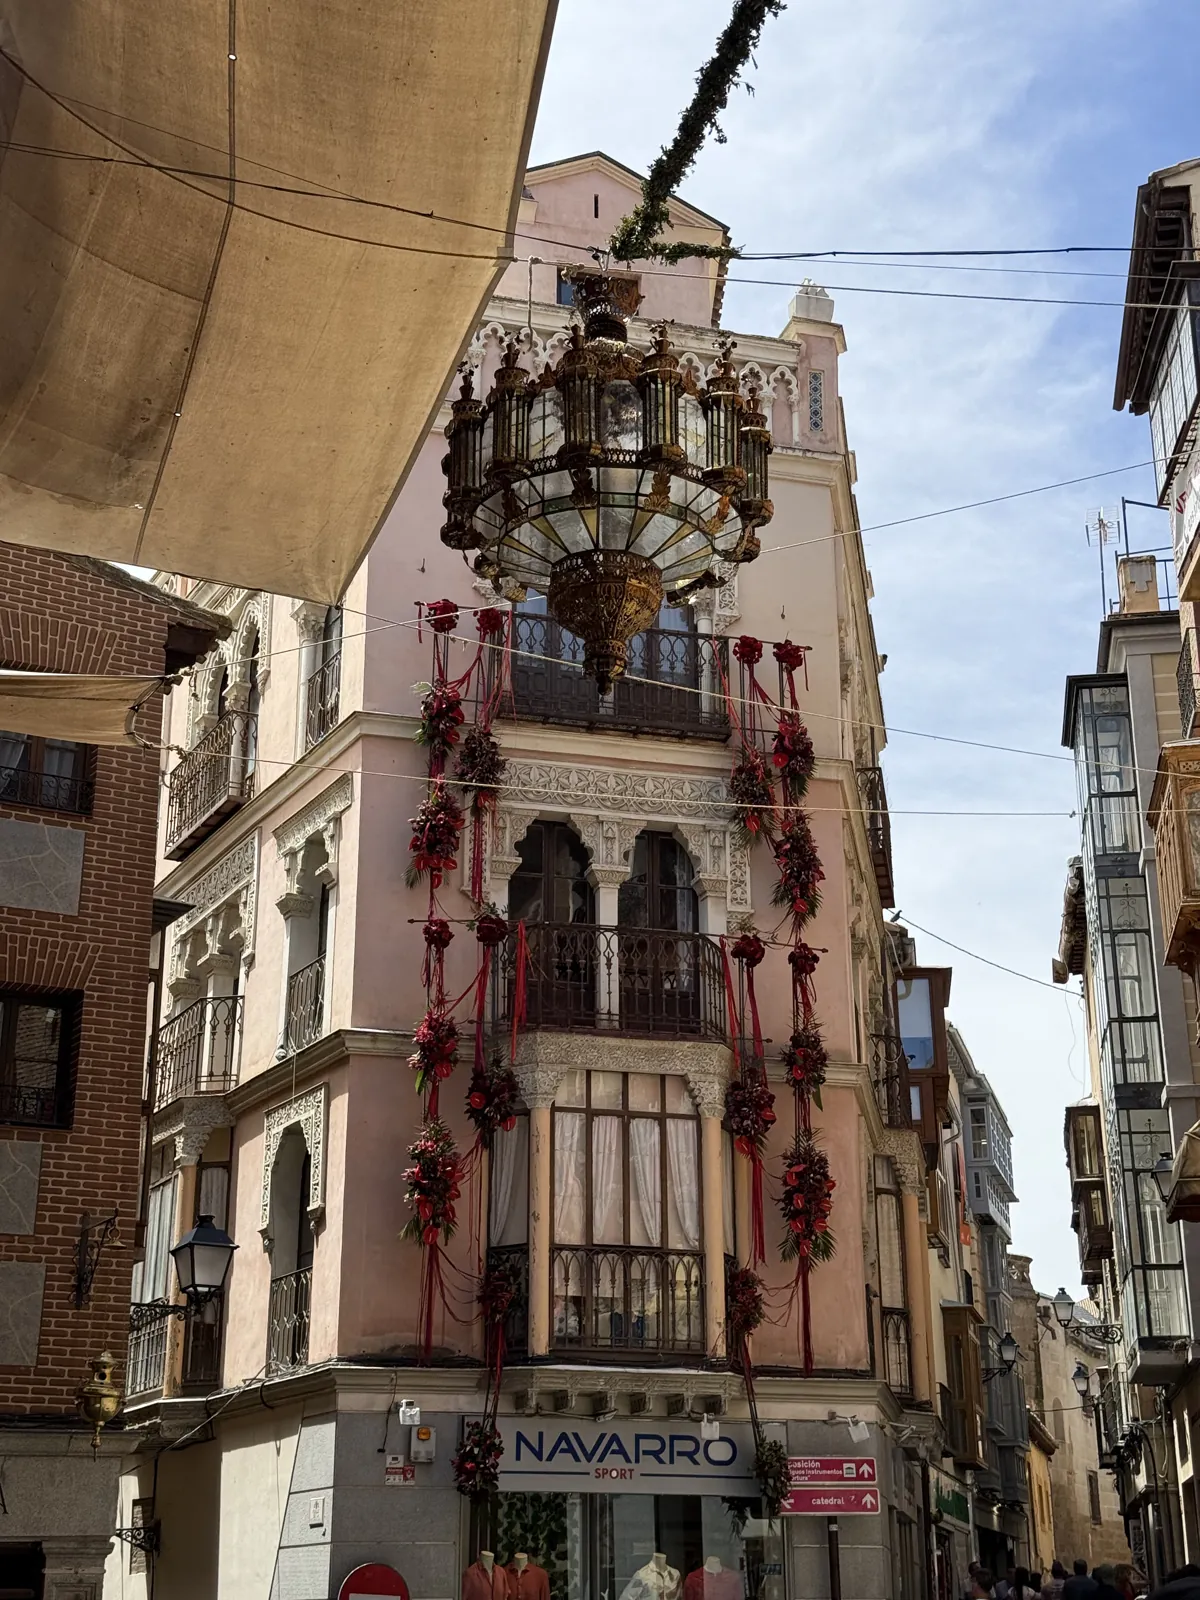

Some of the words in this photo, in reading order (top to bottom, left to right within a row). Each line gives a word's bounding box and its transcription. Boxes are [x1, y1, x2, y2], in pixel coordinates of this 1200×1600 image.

[515, 1430, 738, 1466] NAVARRO
[788, 1460, 820, 1469] posición
[594, 1468, 635, 1480] SPORT
[811, 1497, 844, 1505] catedral
